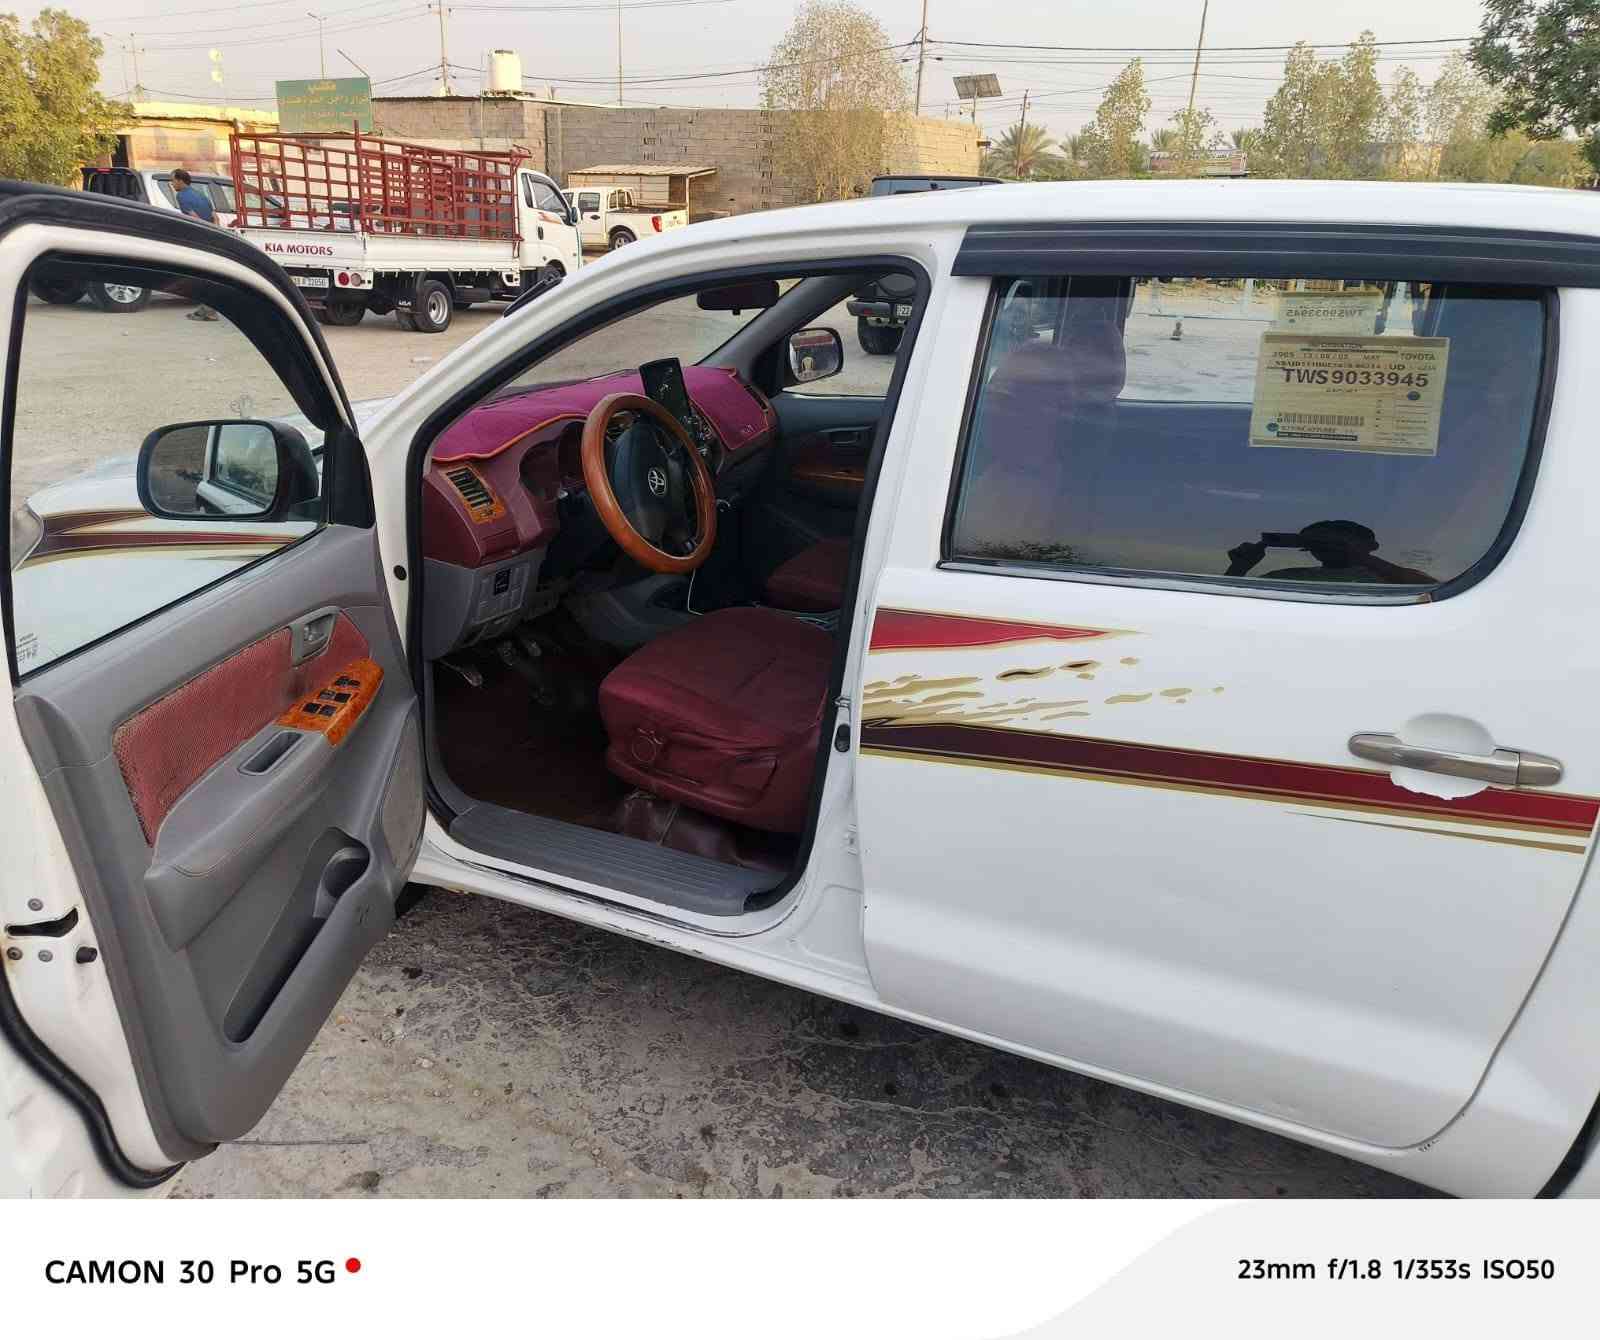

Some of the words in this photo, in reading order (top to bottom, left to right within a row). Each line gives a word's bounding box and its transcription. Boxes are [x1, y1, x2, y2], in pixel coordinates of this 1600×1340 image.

[264, 242, 284, 253] KIA
[286, 244, 334, 256] MOTORS
[1400, 352, 1436, 361] TOYOTA
